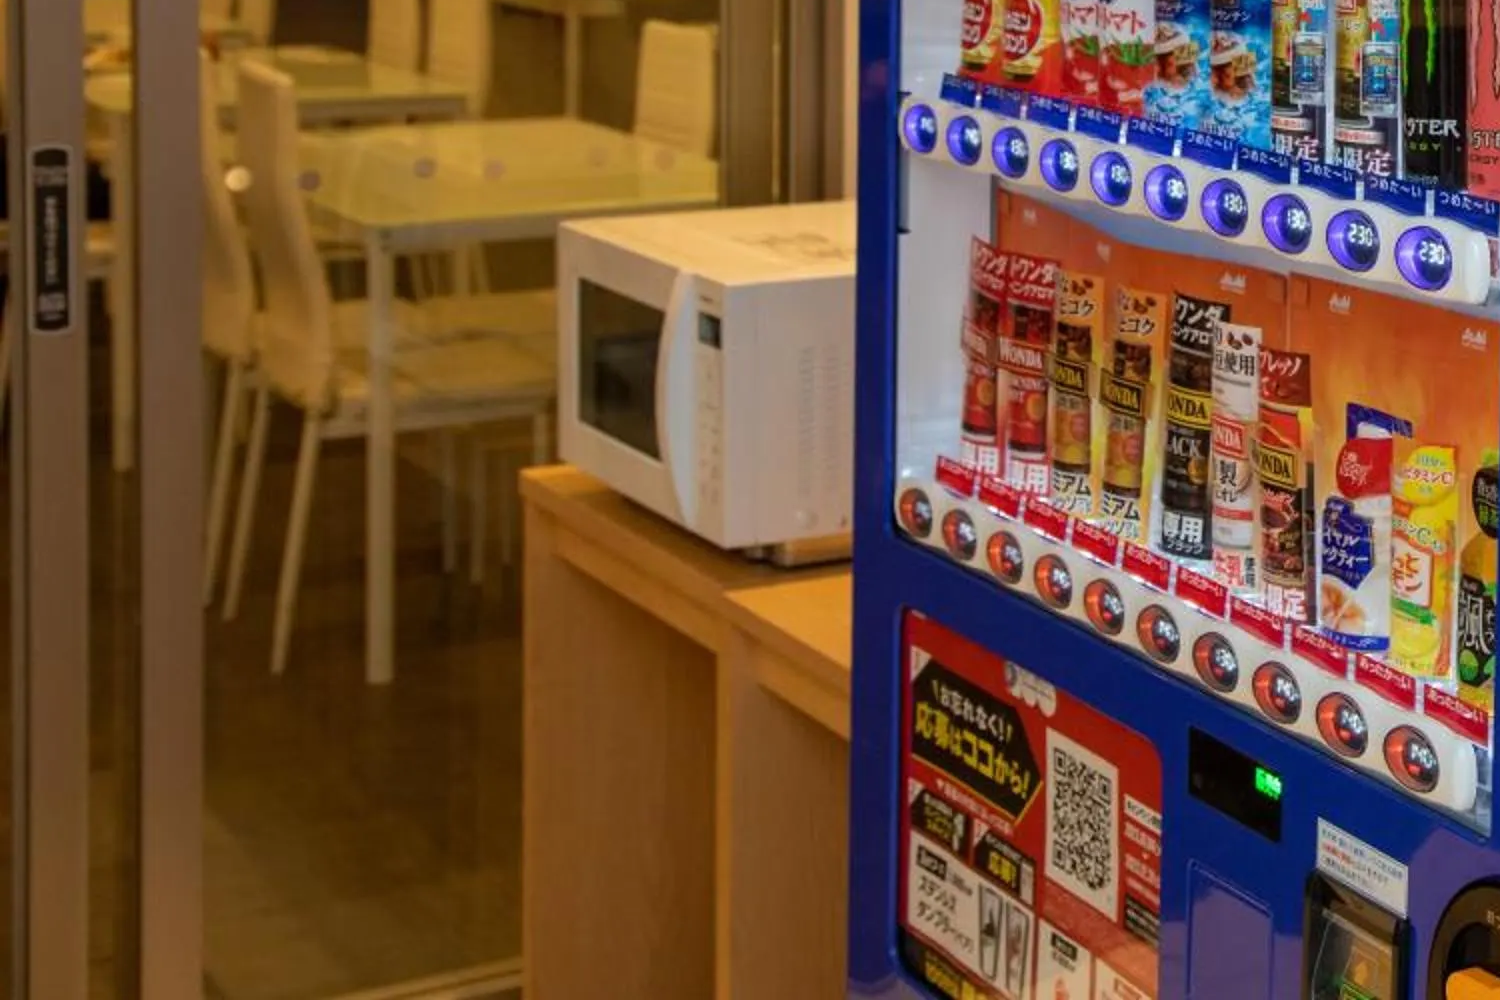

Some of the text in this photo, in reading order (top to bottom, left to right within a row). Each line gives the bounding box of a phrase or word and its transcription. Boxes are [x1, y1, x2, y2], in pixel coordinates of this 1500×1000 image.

[1404, 117, 1461, 138] STER
[1271, 131, 1320, 162] 限定
[1349, 224, 1373, 247] 230
[1421, 242, 1445, 265] 230
